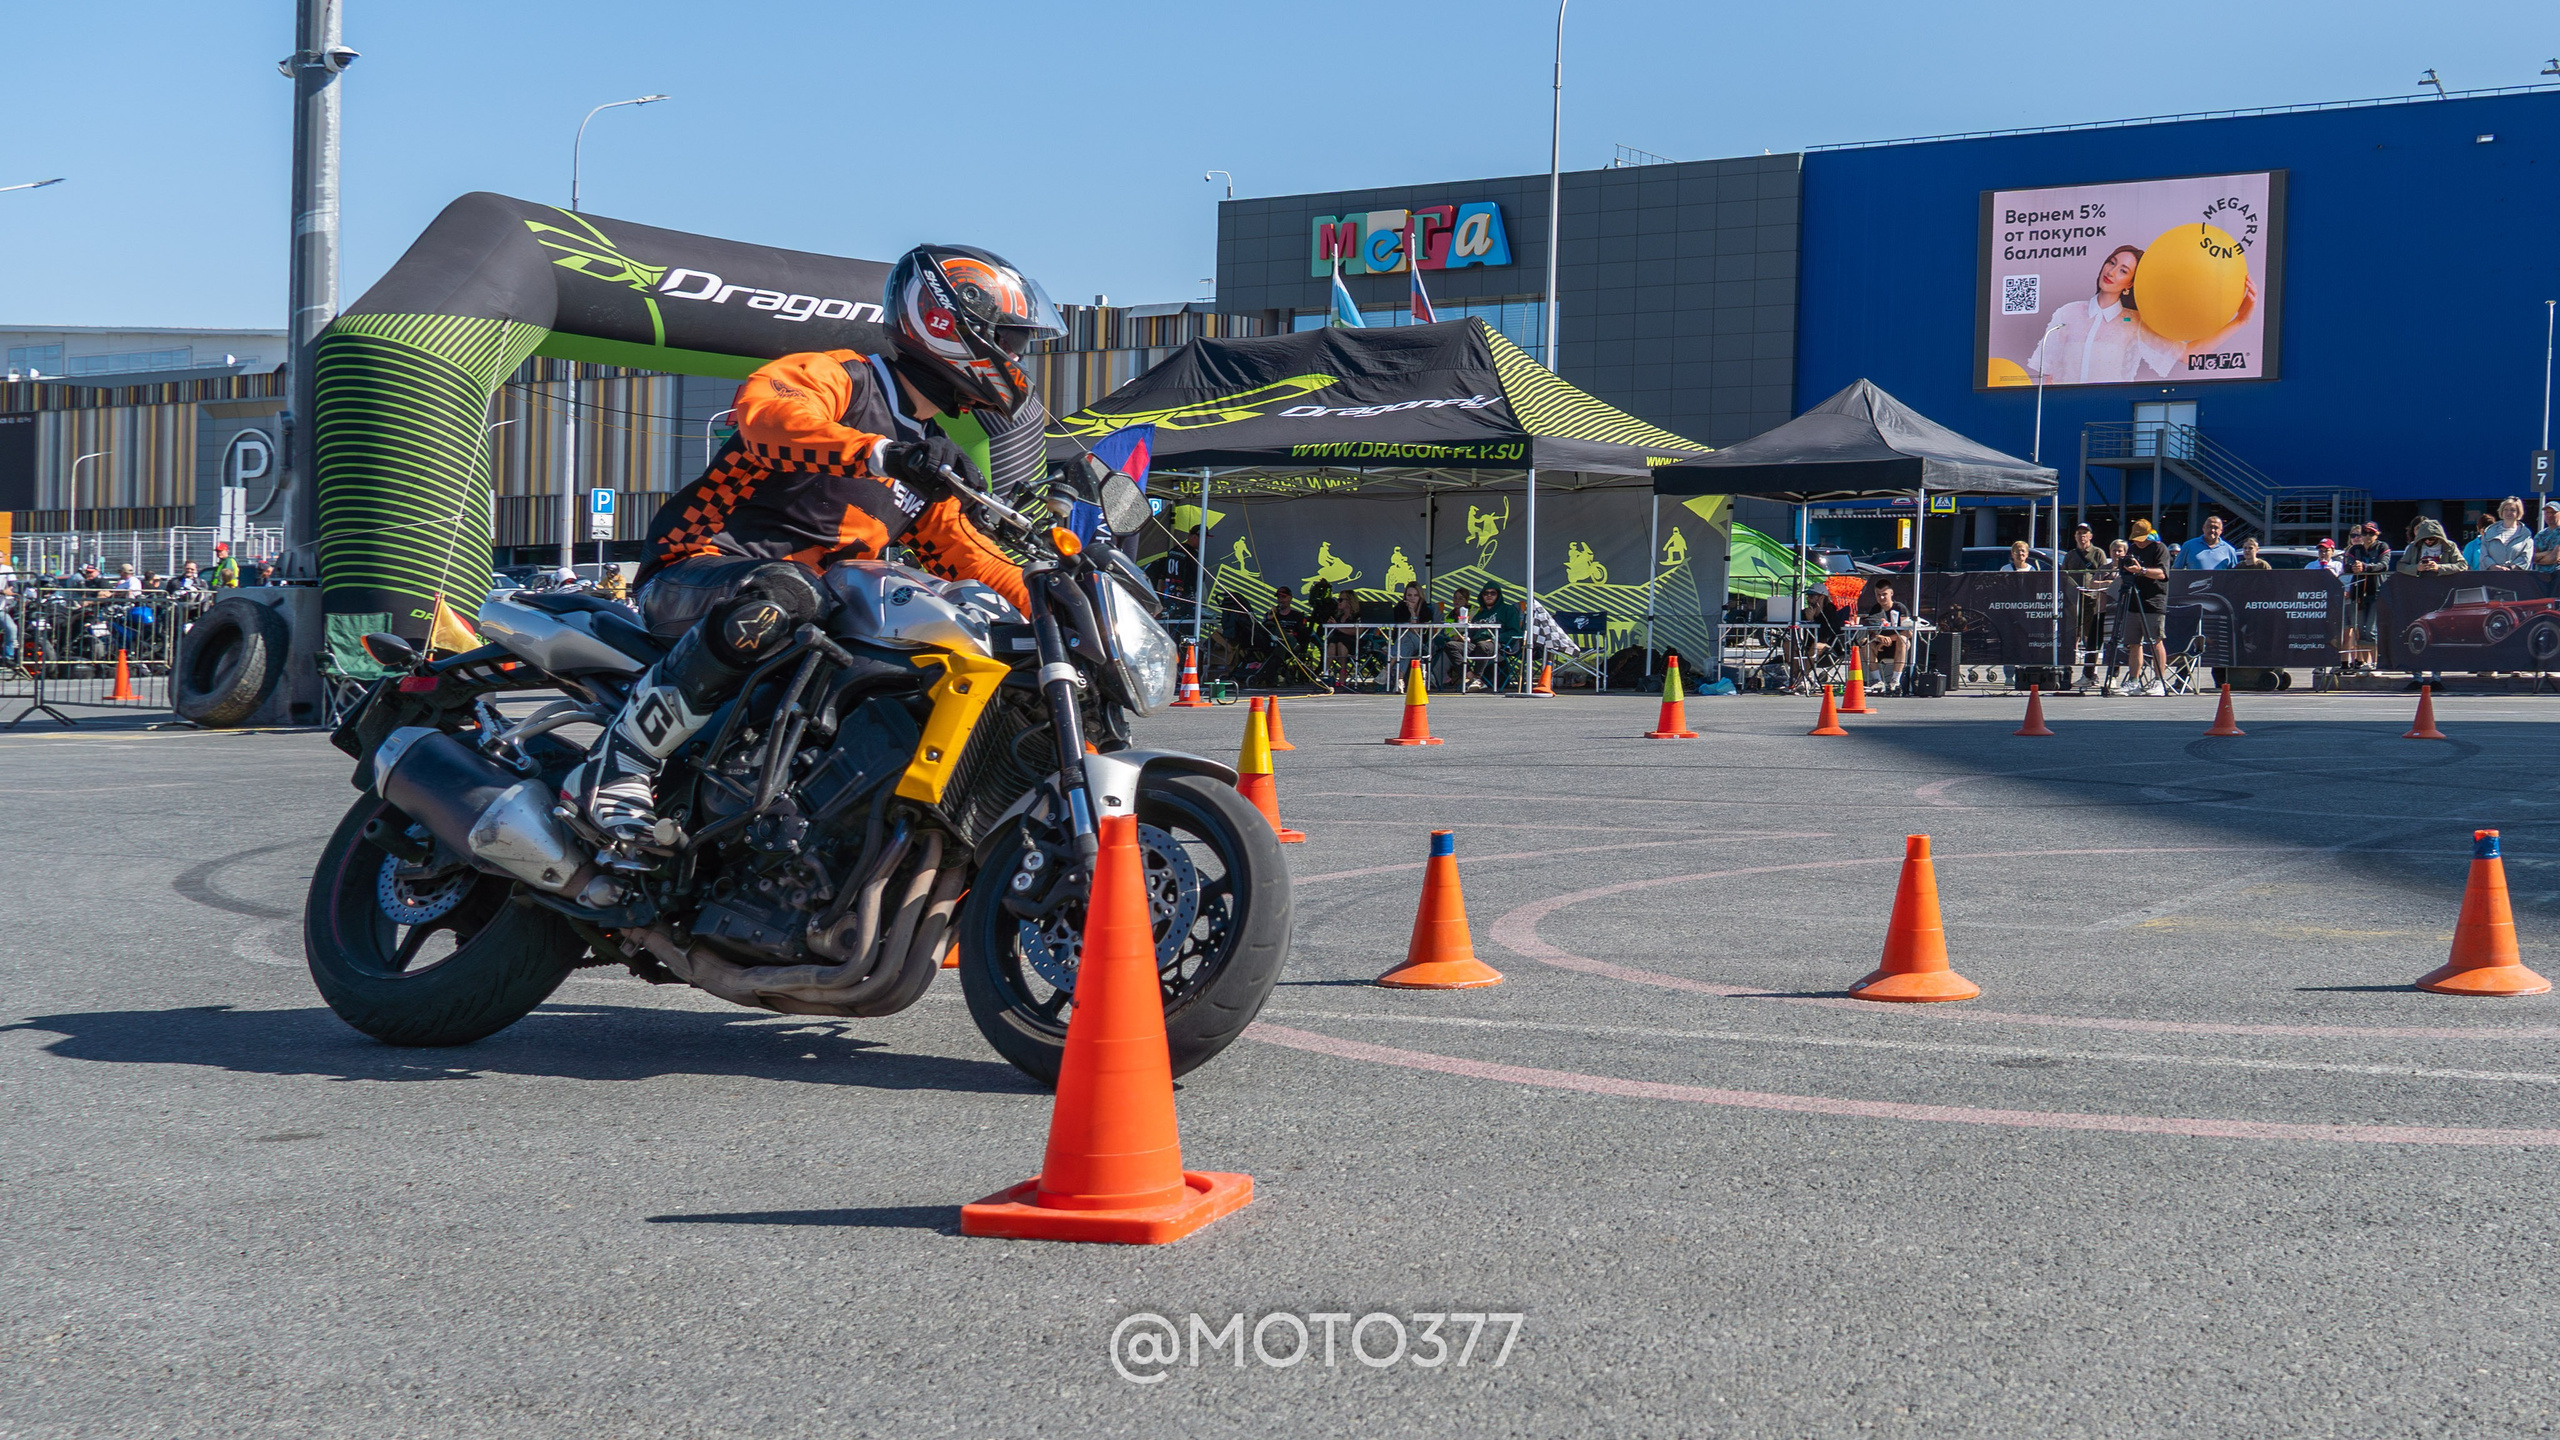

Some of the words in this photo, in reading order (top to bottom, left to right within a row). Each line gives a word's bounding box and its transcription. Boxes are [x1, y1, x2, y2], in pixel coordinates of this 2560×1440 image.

[2005, 210, 2074, 226] Вернем
[2080, 203, 2106, 219] 5%
[2004, 231, 2024, 242] от
[2029, 225, 2106, 242] покупок
[2004, 245, 2087, 260] баллами
[923, 269, 957, 312] SHARK
[930, 315, 950, 331] 12
[236, 441, 269, 488] P
[2537, 456, 2548, 470] Б
[2537, 473, 2547, 485] 7
[597, 491, 611, 511] P
[2036, 591, 2064, 600] МУЗЙ
[2298, 590, 2328, 599] МУЗЕЙ
[2245, 600, 2327, 609] АВТОМОБИЛЬНОЙ
[2025, 611, 2063, 619] ТЕХНИИ
[2286, 611, 2327, 619] ТЕХНИКИ
